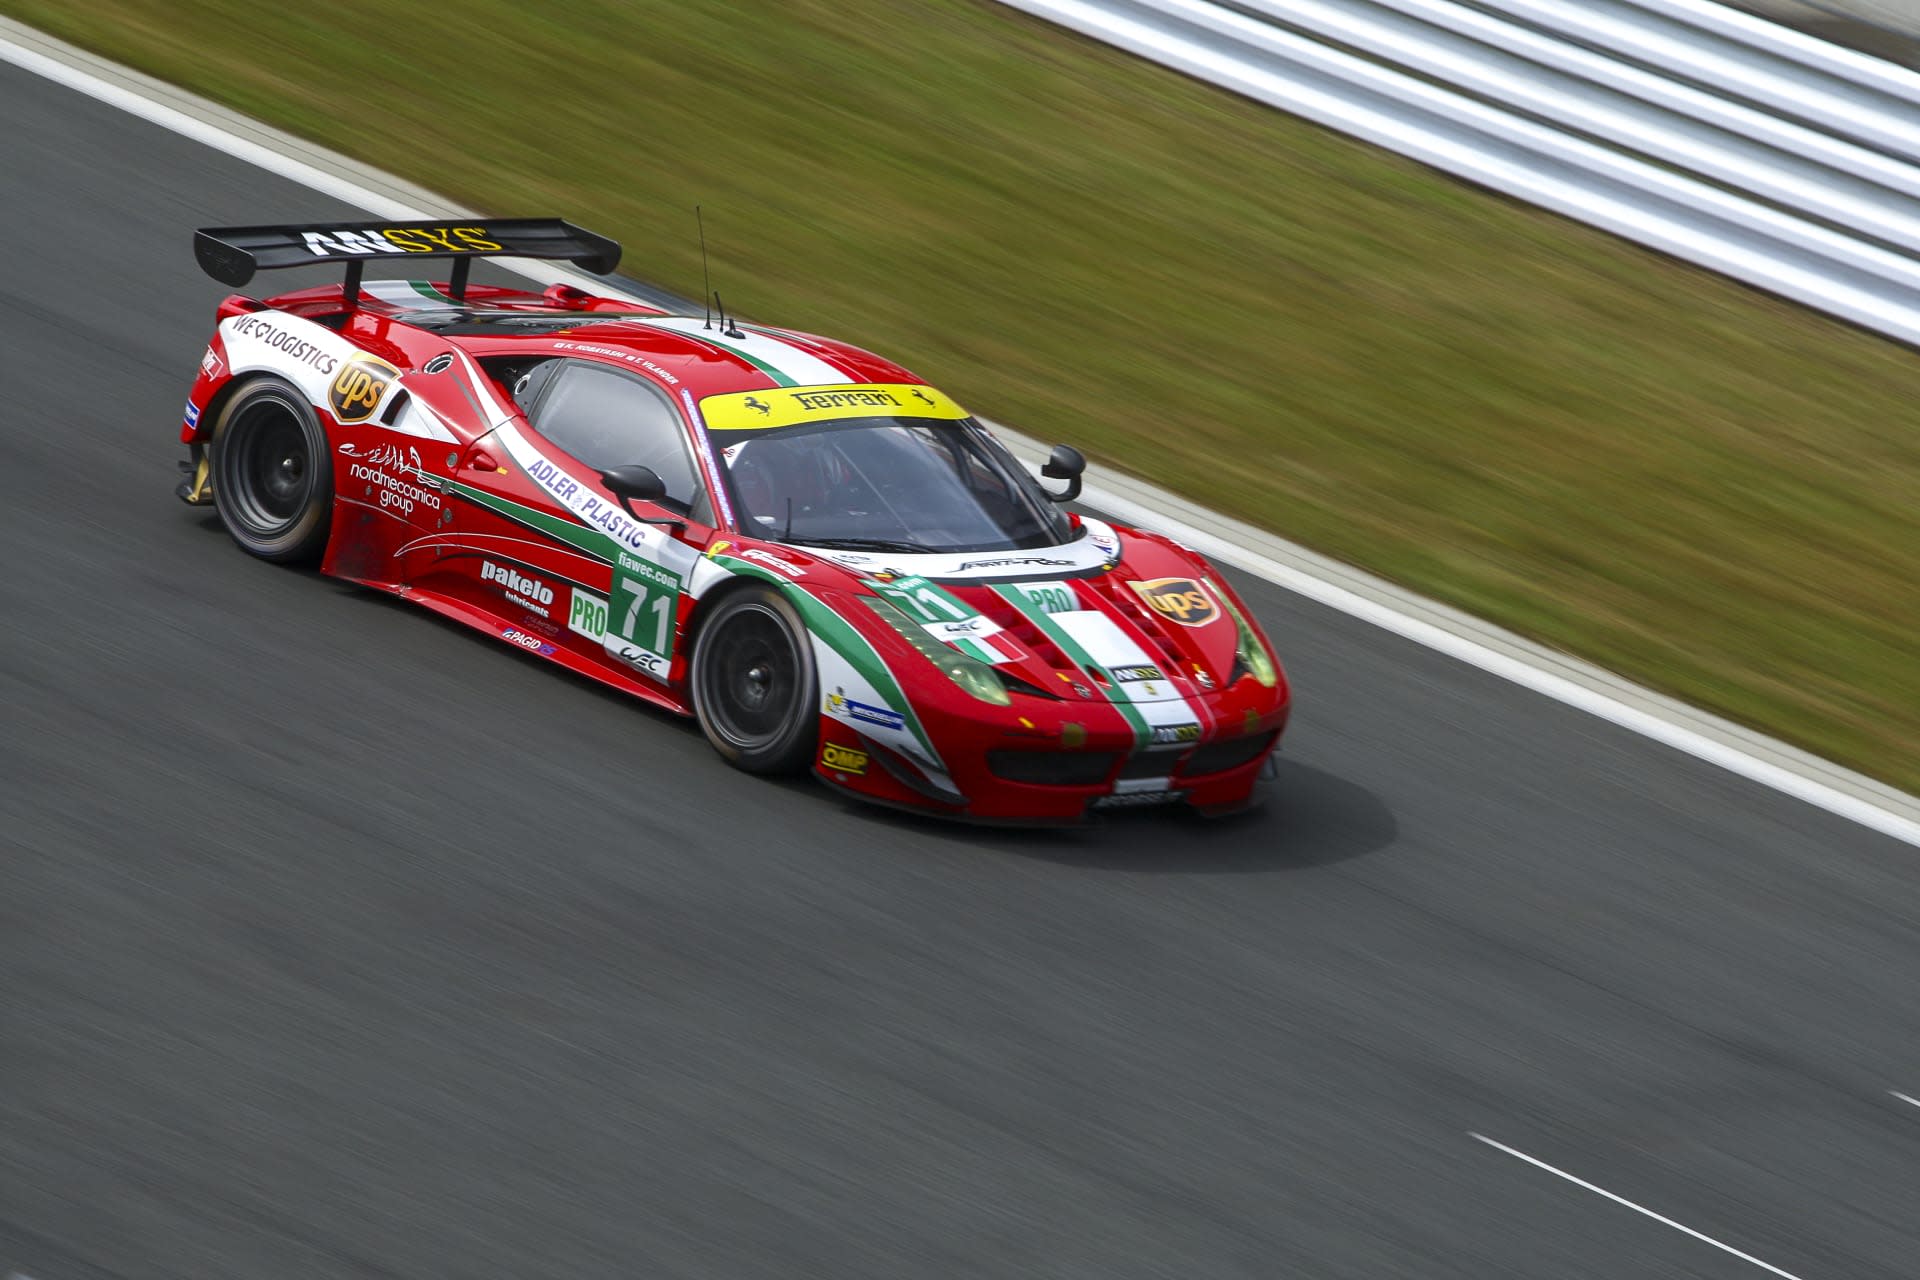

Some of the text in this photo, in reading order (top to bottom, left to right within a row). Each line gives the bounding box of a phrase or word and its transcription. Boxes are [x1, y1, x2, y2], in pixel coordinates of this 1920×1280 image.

[301, 227, 503, 256] ANSYS
[233, 315, 338, 375] WE LOGISTICS
[575, 345, 627, 358] KOBAYASHI
[642, 360, 679, 385] VILANDER
[335, 365, 386, 409] ups
[790, 390, 903, 411] Ferrari
[350, 463, 440, 510] nordmeccanica
[380, 489, 414, 517] group
[528, 460, 645, 548] ADLER PLASTIC
[481, 560, 554, 606] pakelo
[618, 551, 679, 590] fiawec.com
[504, 590, 549, 618] lubricants
[885, 588, 969, 622] 71
[1029, 587, 1073, 612] PRO
[1145, 591, 1211, 619] ups
[571, 594, 607, 638] PRO
[621, 577, 671, 655] 71
[510, 630, 541, 650] PAGID
[620, 646, 662, 672] WEC
[823, 746, 868, 769] OMP
